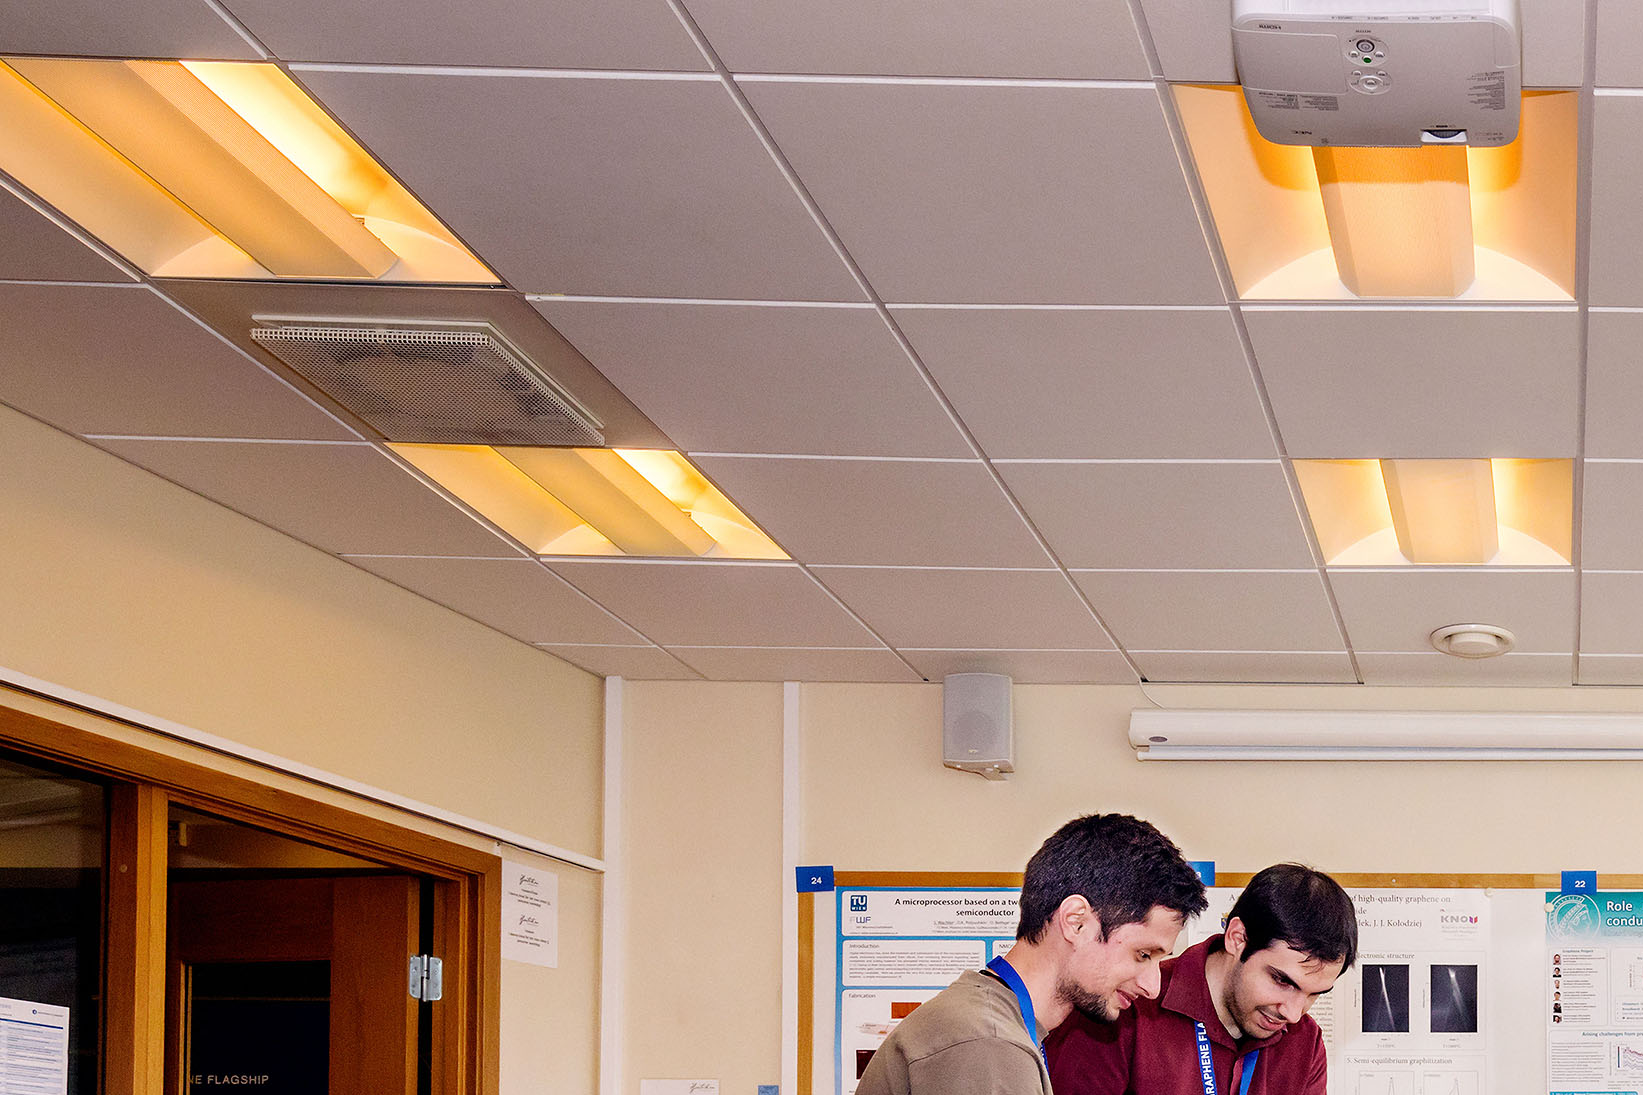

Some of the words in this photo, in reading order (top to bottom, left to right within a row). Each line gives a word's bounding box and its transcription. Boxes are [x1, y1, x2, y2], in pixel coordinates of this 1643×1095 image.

[852, 896, 866, 904] TU
[902, 899, 961, 907] microprocessor
[1405, 895, 1440, 906] graphene
[1606, 900, 1633, 911] Role
[207, 1075, 270, 1085] FLAGSHIP
